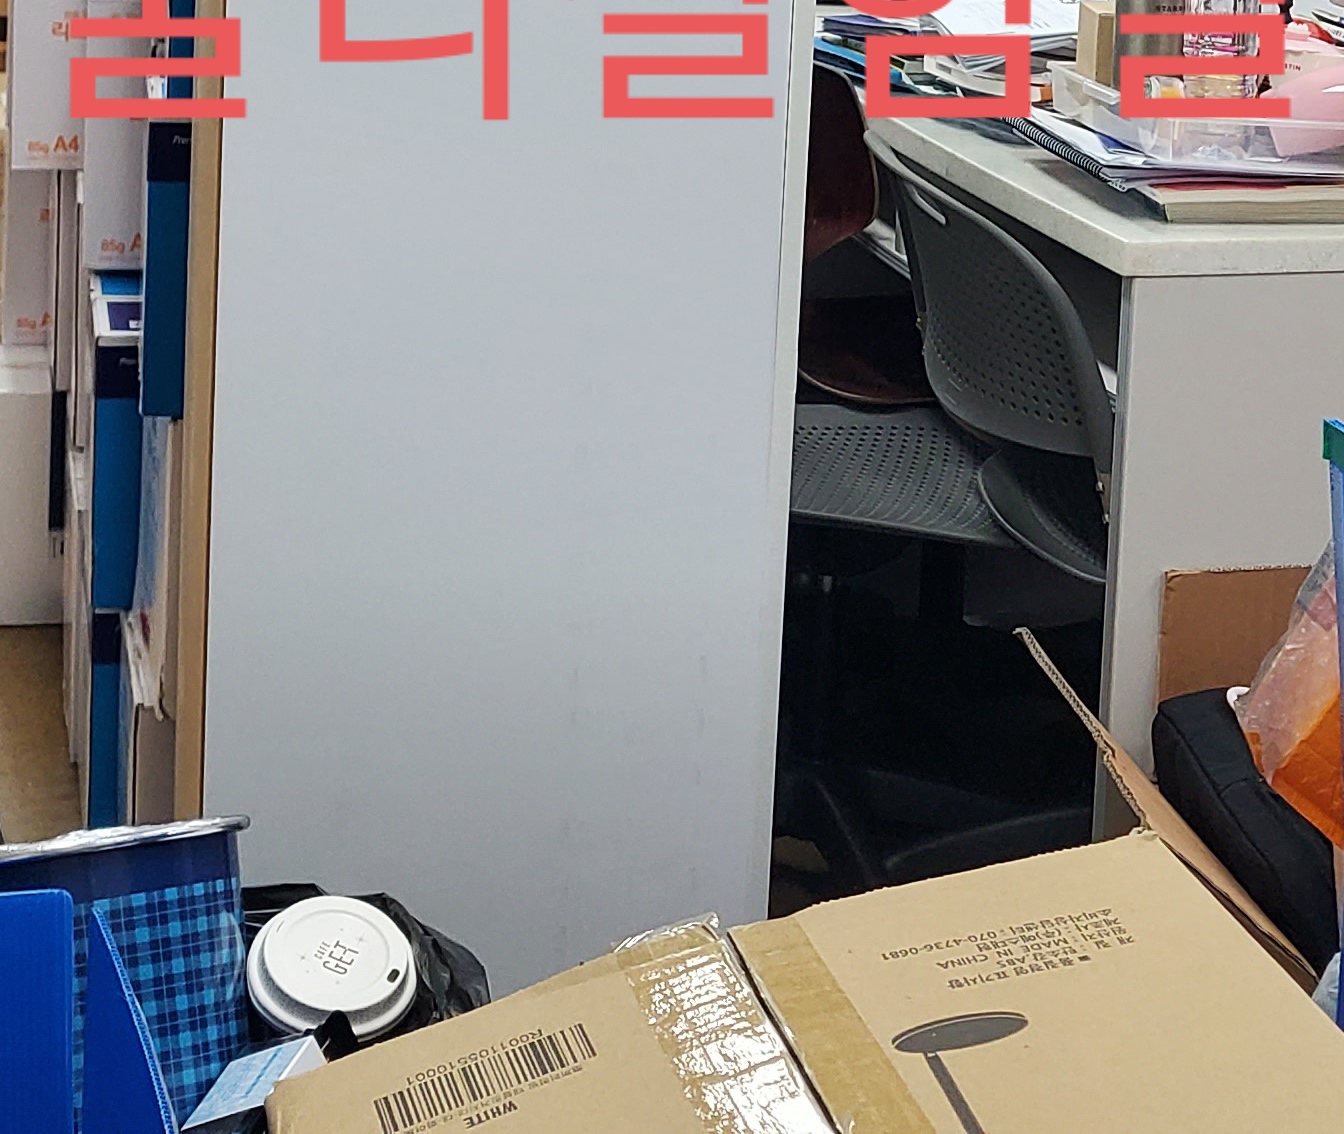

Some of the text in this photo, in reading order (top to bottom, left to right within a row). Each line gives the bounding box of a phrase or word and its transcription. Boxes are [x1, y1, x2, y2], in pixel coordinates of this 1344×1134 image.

[53, 134, 80, 152] A4
[314, 941, 331, 960] CAFE
[996, 948, 1015, 959] IN
[1022, 936, 1069, 954] MADE
[323, 940, 359, 975] GET
[935, 953, 989, 970] CHINA
[406, 1027, 545, 1087] R001105510001
[463, 1099, 520, 1130] WHITE
